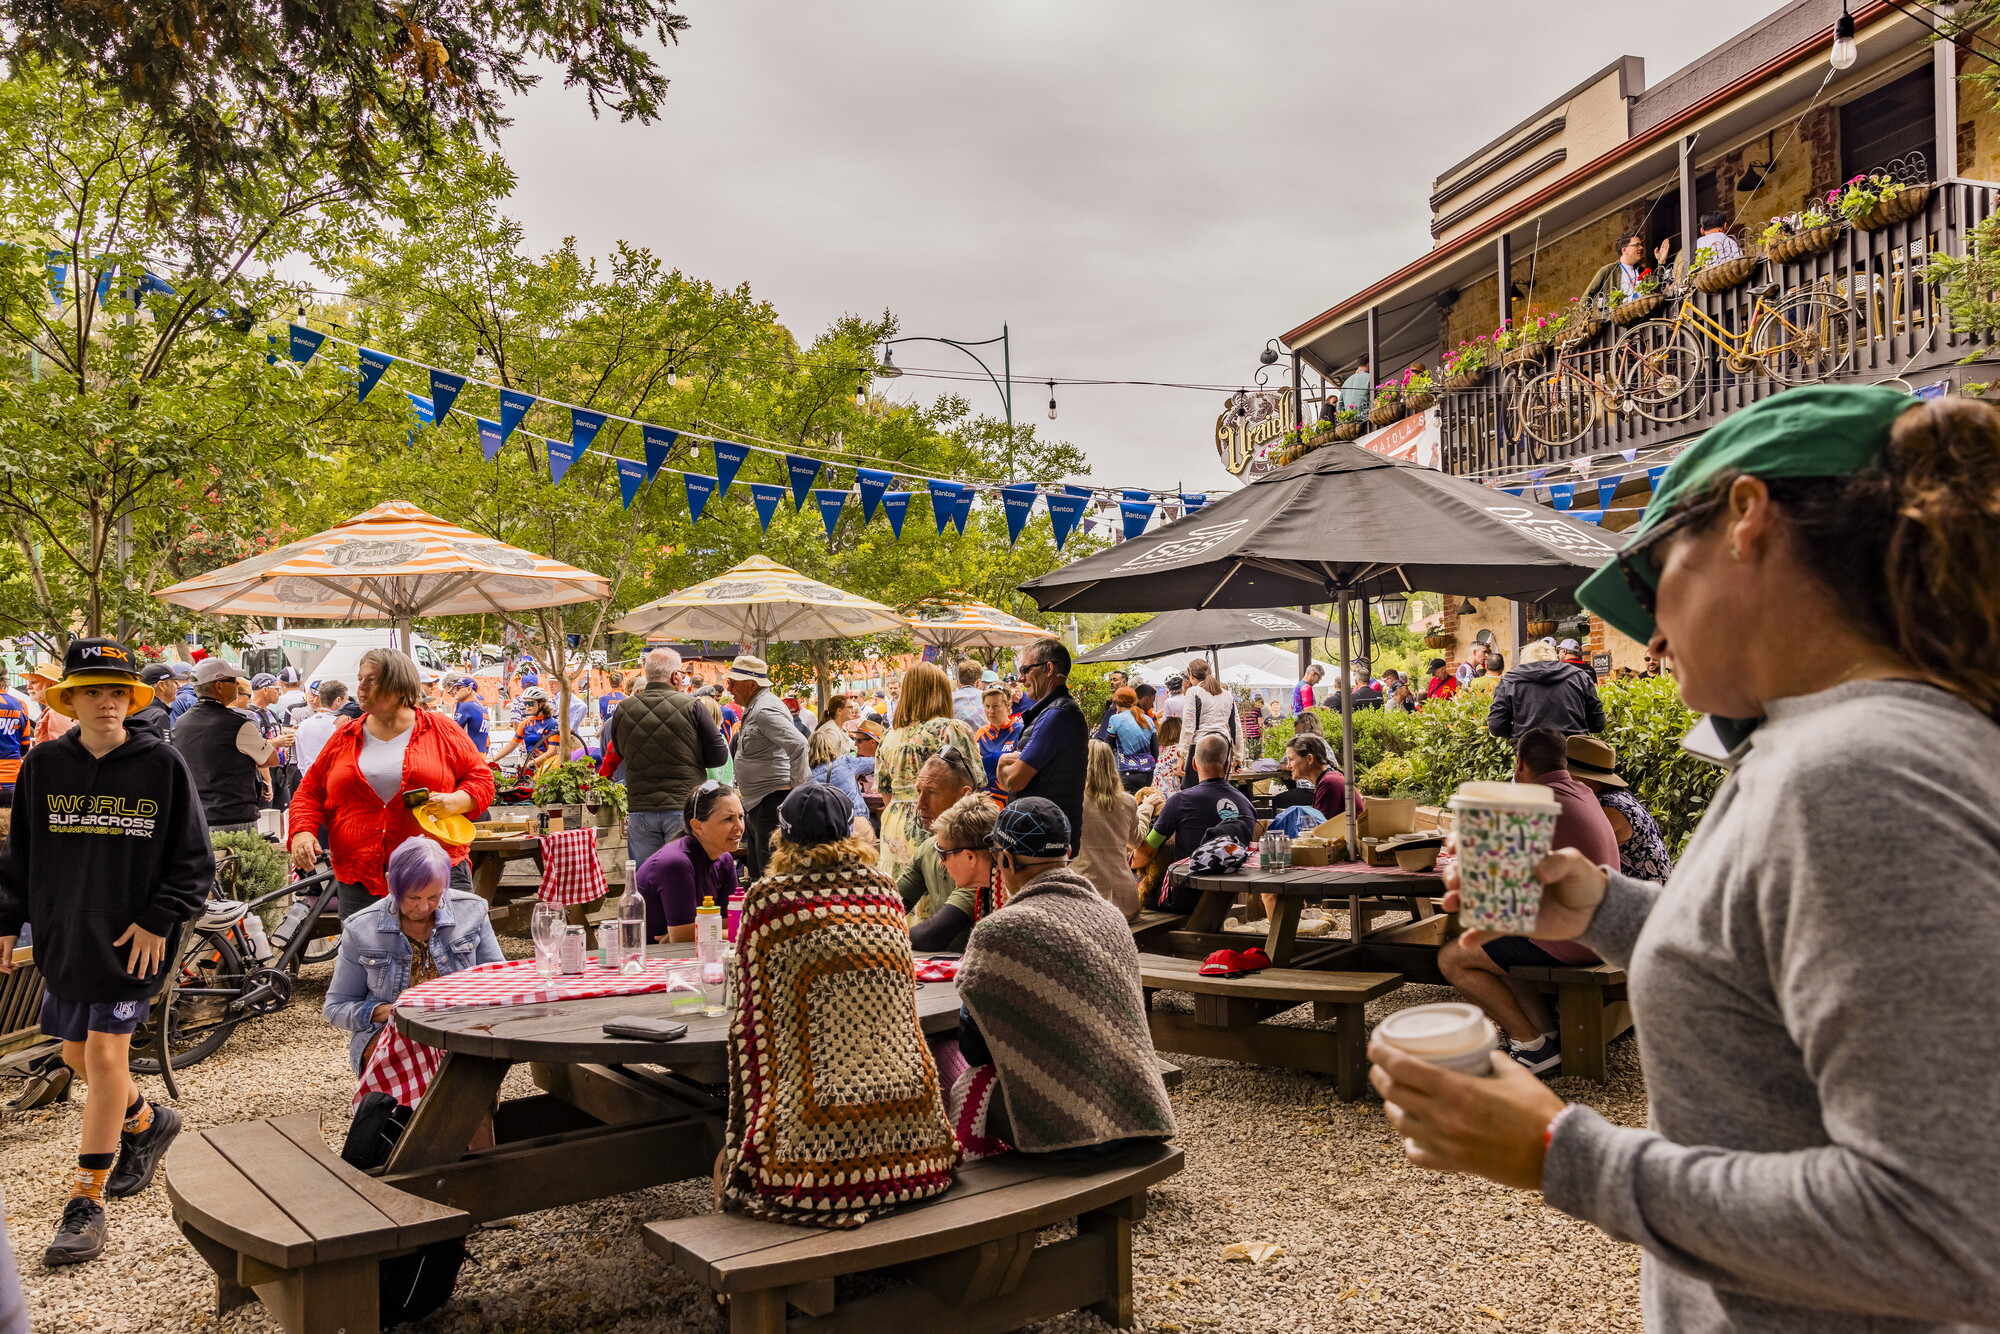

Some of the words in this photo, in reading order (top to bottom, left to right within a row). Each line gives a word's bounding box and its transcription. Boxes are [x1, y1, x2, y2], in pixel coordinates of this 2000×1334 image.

[293, 336, 316, 348] Santos
[362, 357, 384, 370] Santos
[434, 381, 456, 393] Santos
[412, 403, 433, 416] Santos
[503, 400, 525, 411] Santos
[575, 419, 597, 430] Santos
[1371, 415, 1425, 453] RAIDLA'S
[647, 436, 669, 447] Santos
[550, 449, 572, 460] Santos
[718, 452, 740, 462] Santos
[621, 468, 641, 479] Santos
[791, 466, 814, 476] Santos
[689, 483, 709, 493] Santos
[862, 477, 885, 488] Santos
[756, 493, 777, 502] Santos
[934, 489, 956, 498] Santos
[821, 499, 841, 507] Santos
[1006, 498, 1029, 507] Santos
[1052, 505, 1074, 513] Santos
[1124, 511, 1147, 520] Santos
[47, 794, 158, 817] WORLD
[48, 813, 156, 830] SUPERCROSS
[49, 824, 124, 835] CHAMPINSHIP
[125, 828, 153, 839] WSX
